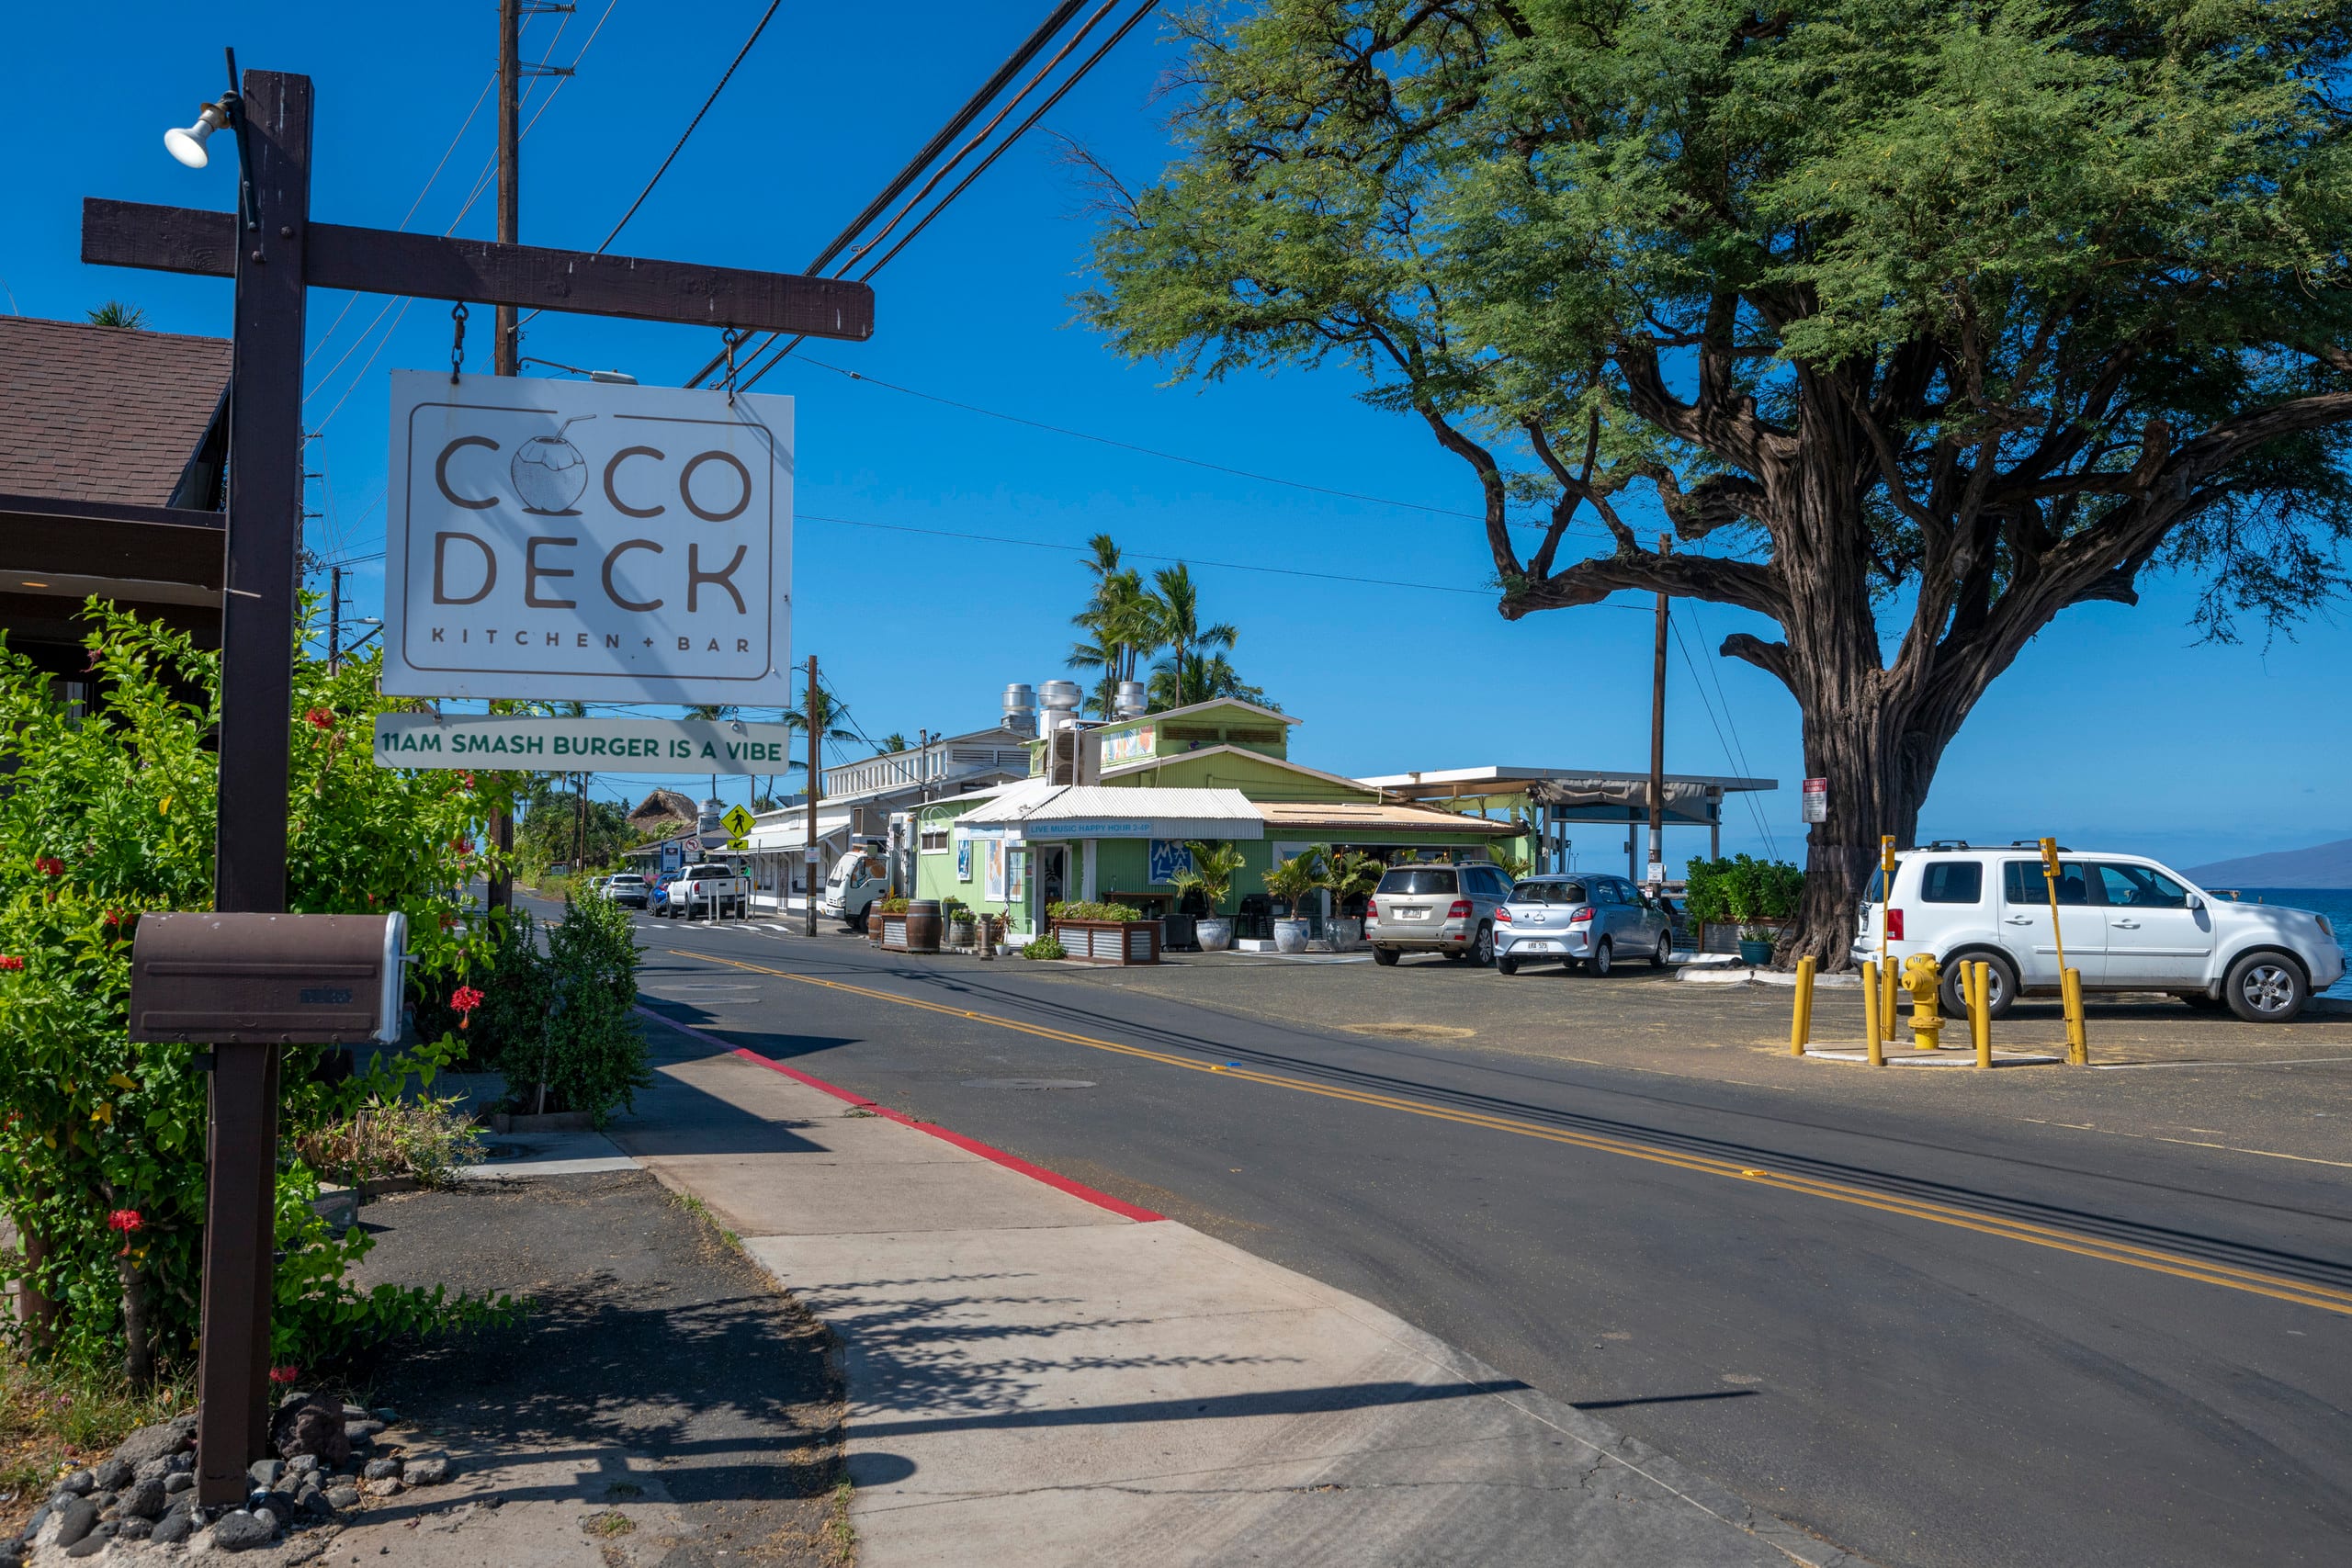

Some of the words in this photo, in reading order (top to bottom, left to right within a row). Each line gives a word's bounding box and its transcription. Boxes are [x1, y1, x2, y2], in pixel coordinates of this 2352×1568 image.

[433, 531, 748, 615] DECK
[431, 626, 619, 649] KITCHEN
[643, 637, 654, 648] +
[677, 636, 750, 653] BAR
[380, 733, 442, 753] 11AM
[451, 734, 544, 755] SMASH
[553, 736, 660, 757] BURGER
[669, 739, 691, 759] IS
[700, 739, 718, 759] A
[727, 740, 782, 761] VIBE
[1079, 824, 1105, 832] HAPPY
